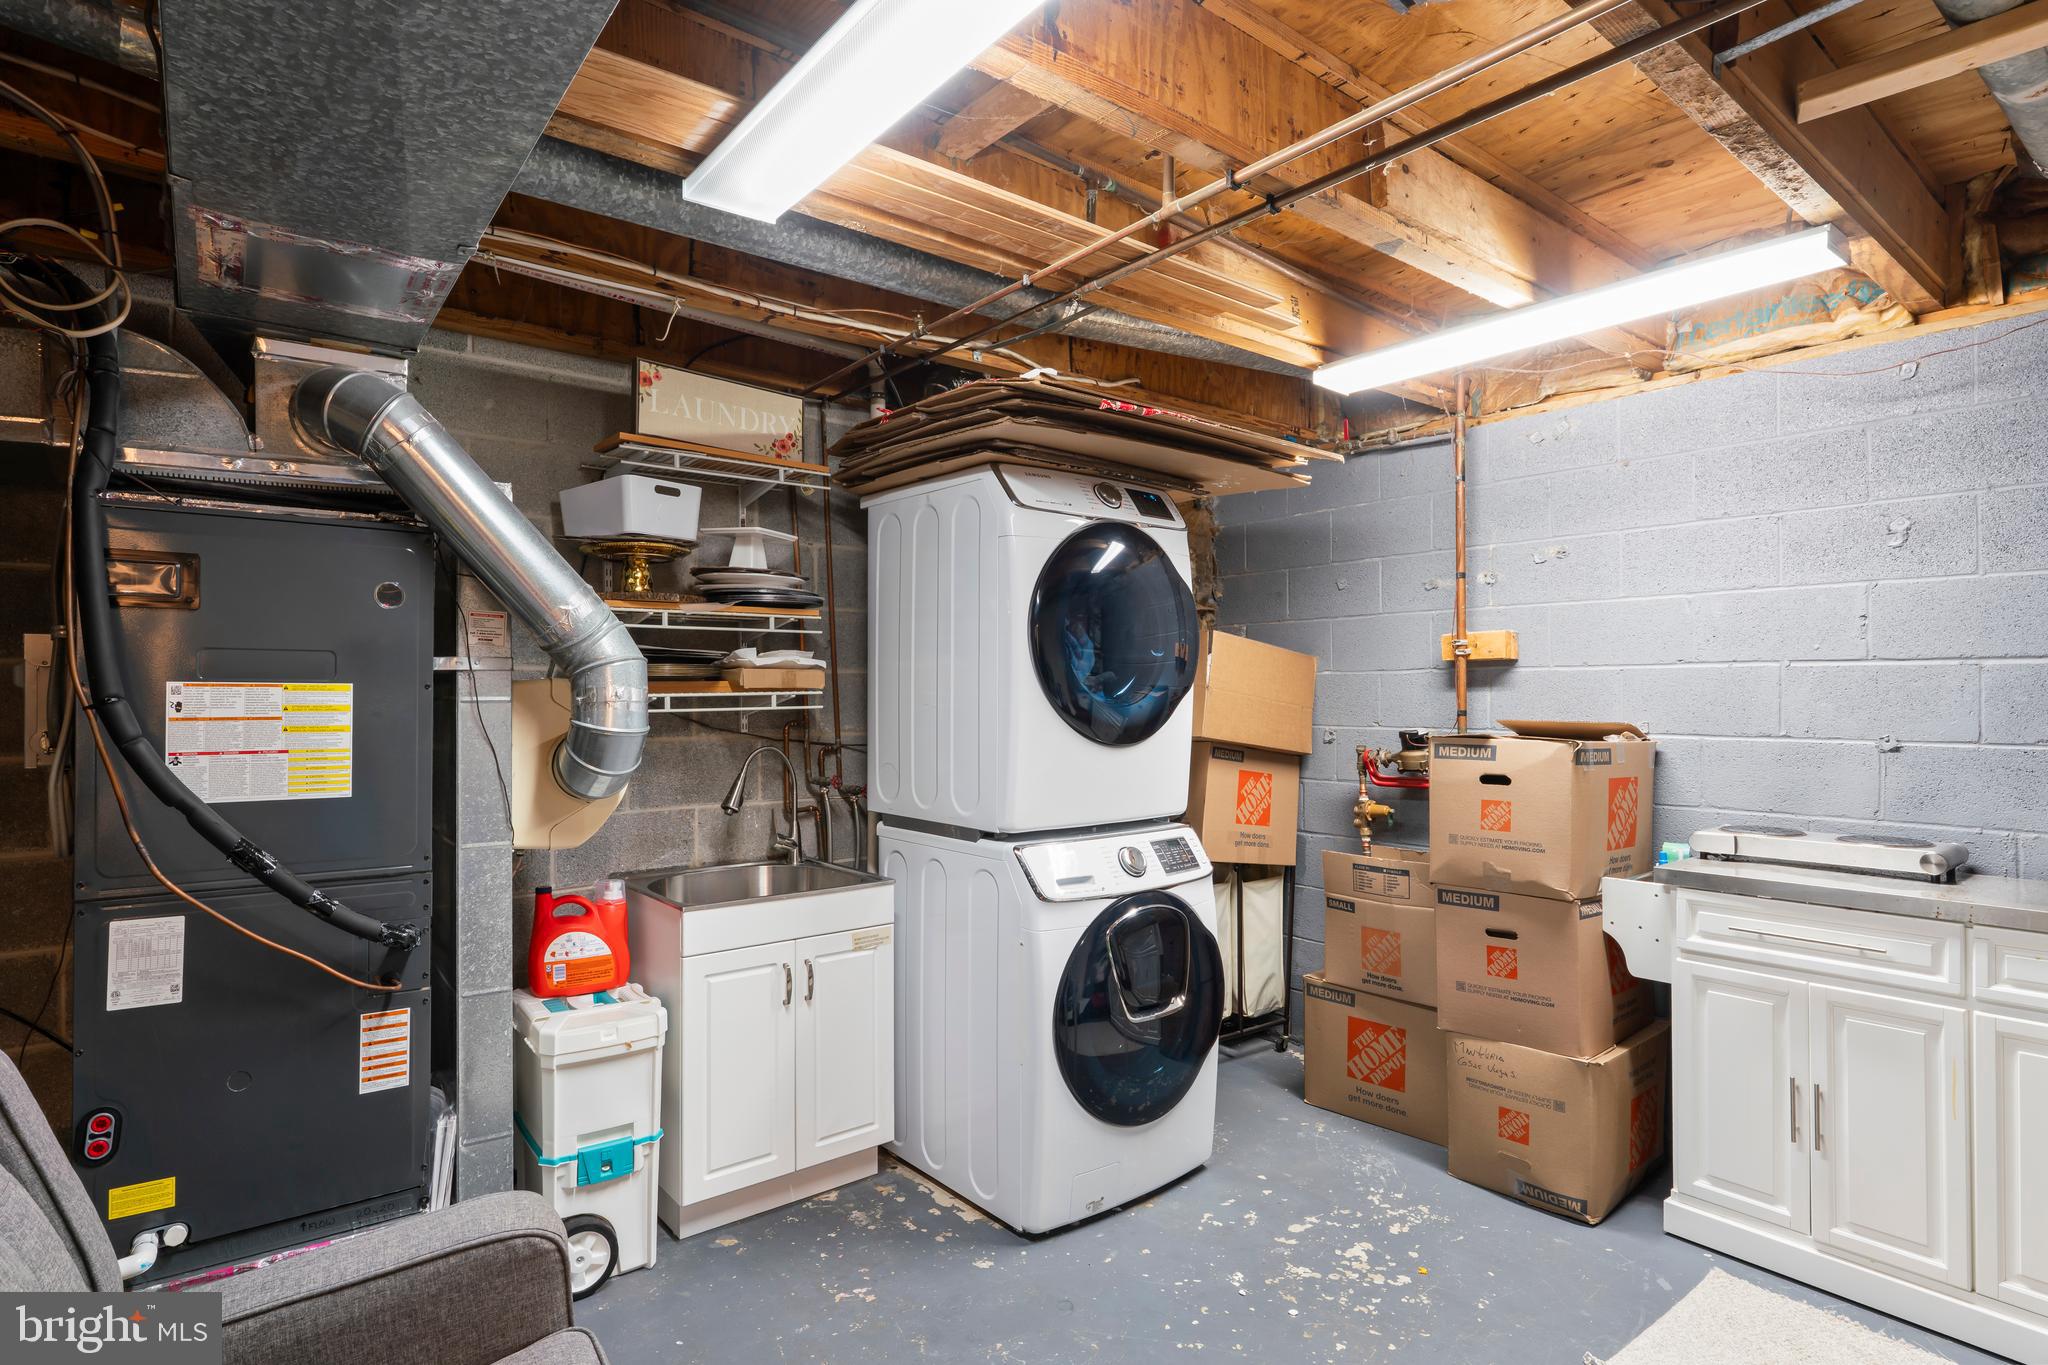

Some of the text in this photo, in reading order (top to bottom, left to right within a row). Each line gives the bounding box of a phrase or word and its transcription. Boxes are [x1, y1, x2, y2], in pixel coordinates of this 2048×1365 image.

[650, 389, 795, 435] LAUNDRY
[1214, 748, 1243, 761] MEDIUM
[1439, 746, 1492, 758] MEDIUM
[1580, 751, 1609, 763] MEDIUM
[1240, 776, 1257, 798] THE
[1236, 773, 1272, 824] HOME
[1249, 792, 1272, 825] DEPOT
[1481, 801, 1511, 830] HOME
[1485, 803, 1498, 815] THE
[1607, 777, 1638, 850] HOME
[1492, 812, 1511, 831] DEPOT
[1480, 836, 1503, 844] ESTIMATE
[1501, 845, 1546, 854] HDMOVING.COM
[1328, 899, 1353, 911] SMALL
[1441, 891, 1495, 909] MEDIUM
[1362, 932, 1401, 970] HOME
[1490, 950, 1503, 961] THE
[1487, 947, 1518, 977] HOME
[1499, 959, 1518, 978] DEPOT
[1367, 972, 1397, 984] How doers
[1372, 980, 1386, 988] more
[1309, 986, 1352, 1005] MEDIUM
[1467, 983, 1487, 991] QUICKLY
[1513, 990, 1527, 998] YOUR
[1467, 988, 1485, 996] SUPPLY
[1486, 991, 1502, 999] NEEDS
[1510, 995, 1555, 1008] HDMOVING.COM
[1352, 1027, 1377, 1050] THE
[1348, 1026, 1406, 1080] HOME
[1369, 1051, 1406, 1085] DEPOT
[1348, 1093, 1408, 1117] get more done.
[1355, 1085, 1400, 1105] How doers
[1499, 1112, 1529, 1138] HOME
[1519, 1184, 1582, 1213] MEDIUM
